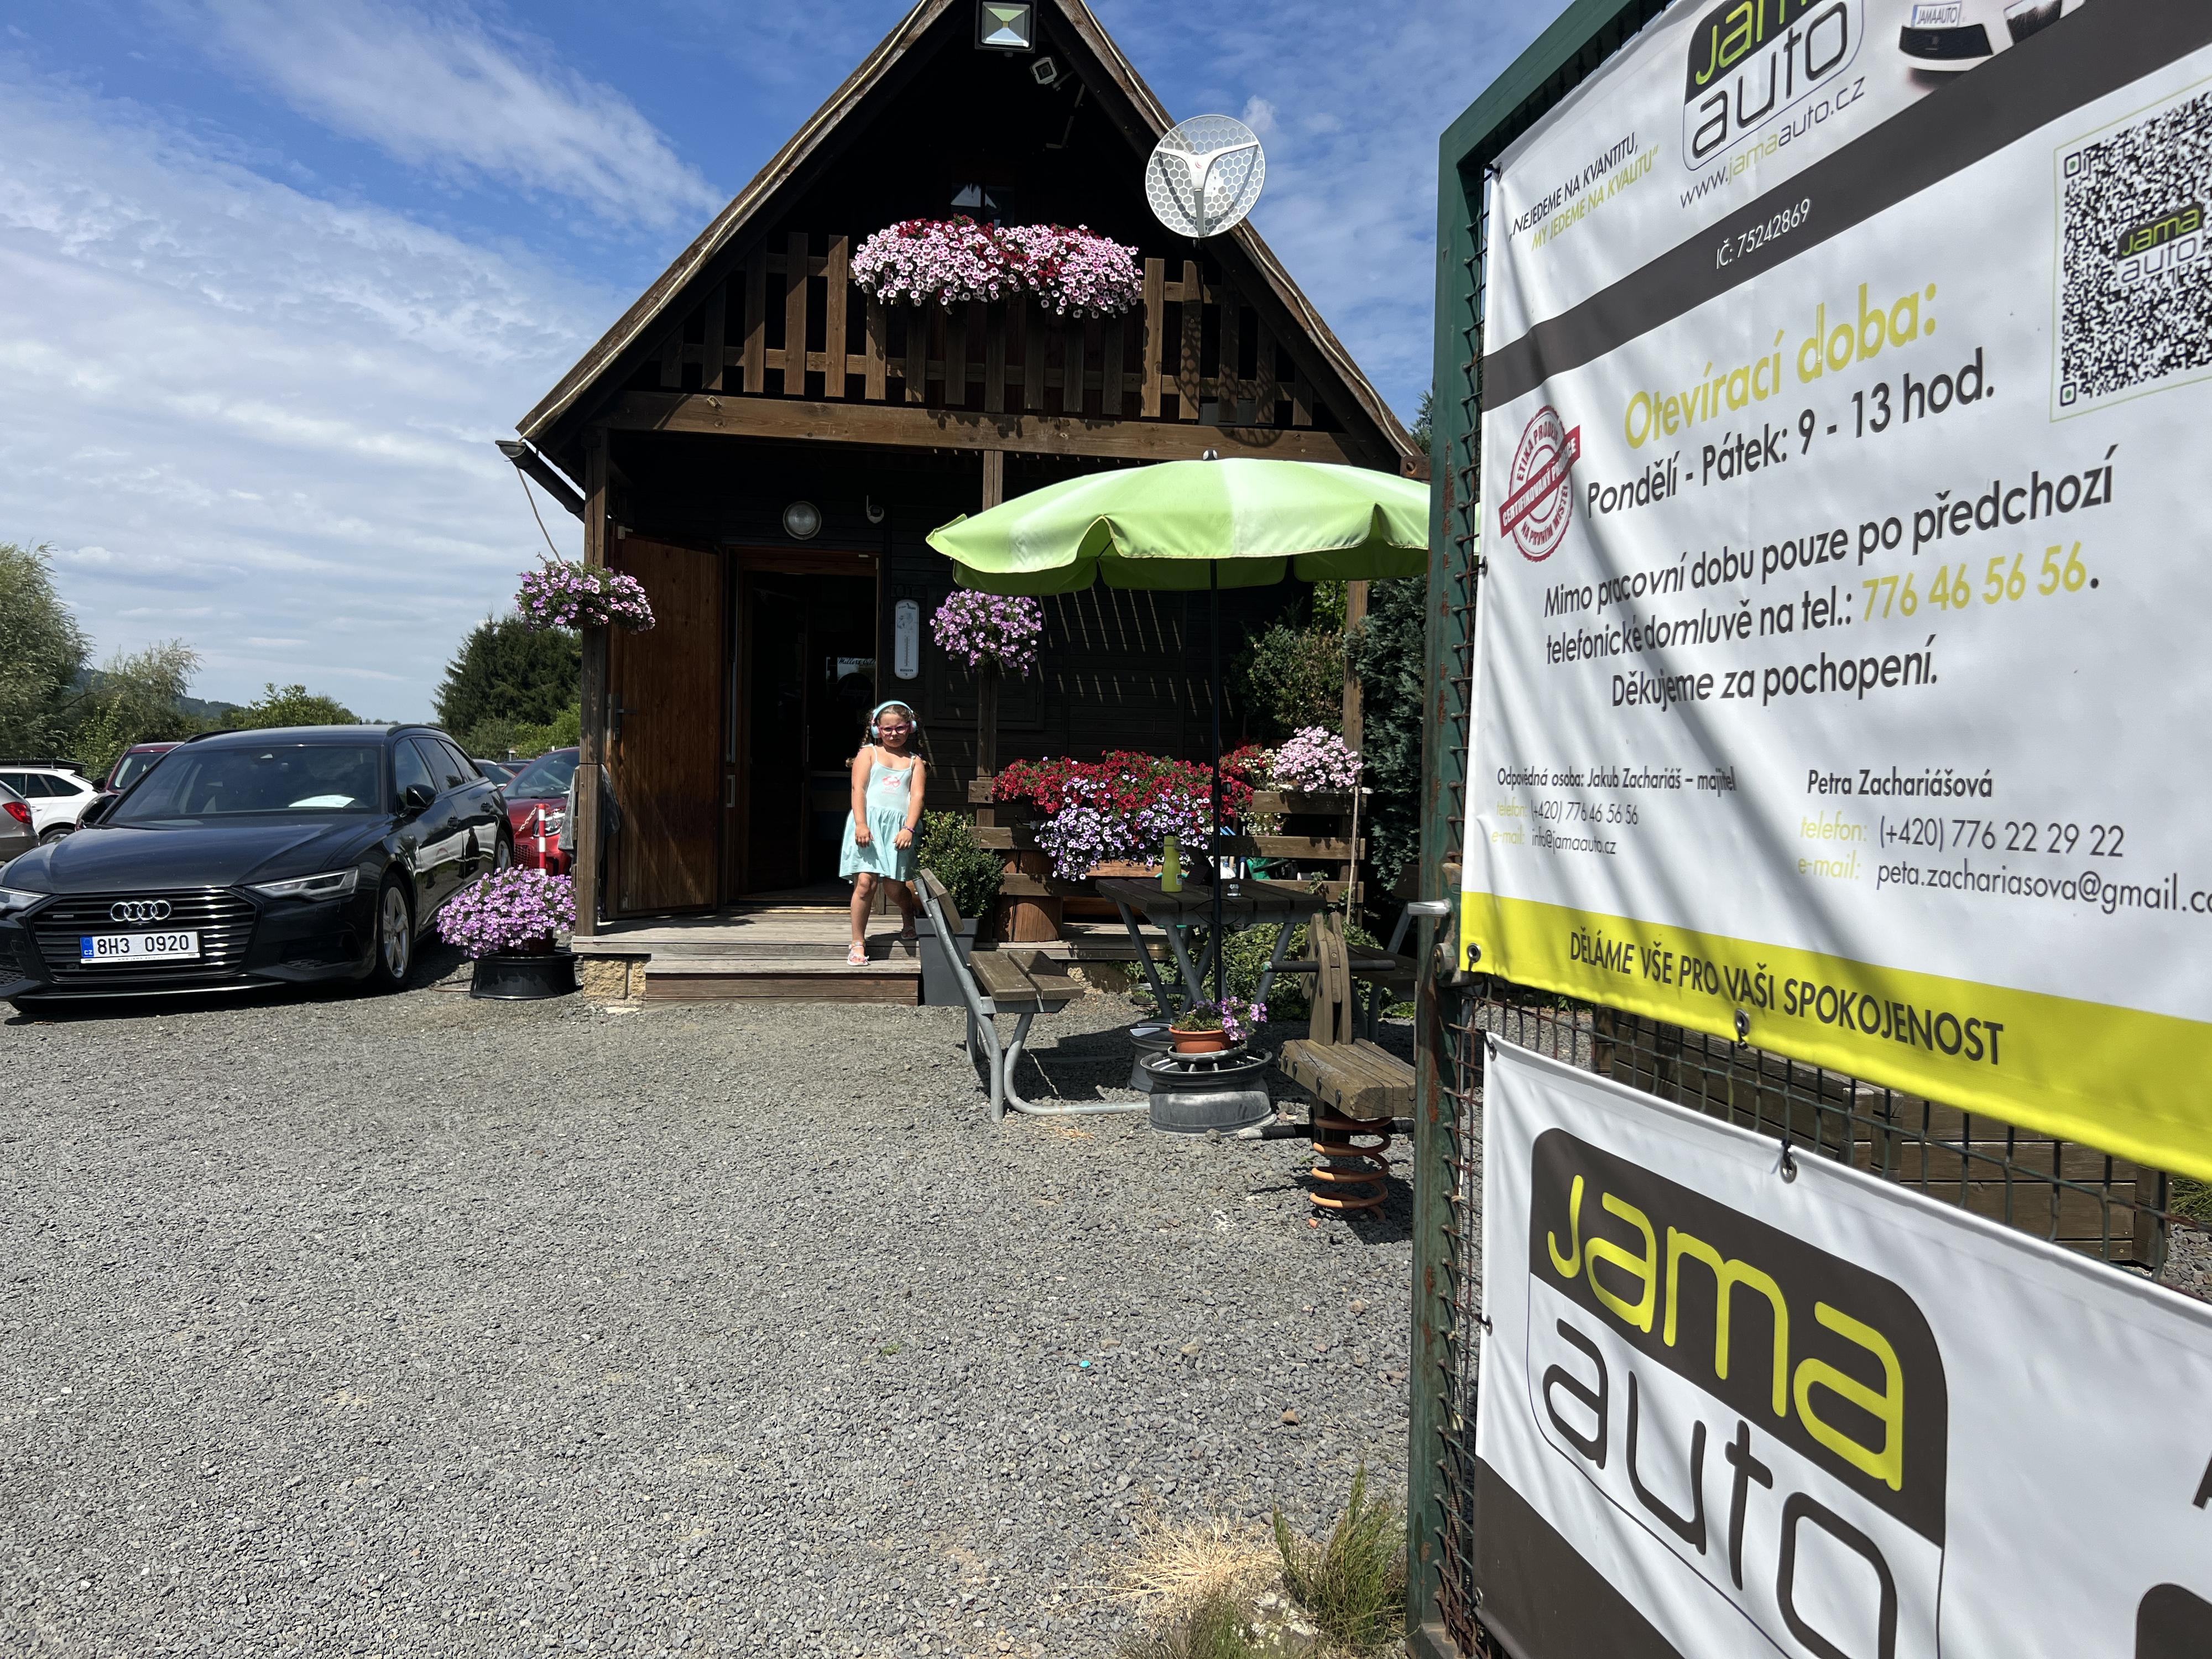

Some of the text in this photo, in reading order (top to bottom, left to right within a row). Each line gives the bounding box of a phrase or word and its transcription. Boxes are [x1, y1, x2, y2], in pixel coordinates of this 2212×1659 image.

[1917, 7, 1958, 24] JAMAAUTO
[1692, 1, 1847, 159] auto
[1564, 176, 1580, 197] NA
[1583, 132, 1638, 186] KVANTITU,
[1680, 76, 1865, 207] www.jamaauto.cz
[1531, 229, 1546, 252] MY
[1549, 200, 1586, 239] JEDEME
[1588, 189, 1604, 210] NA
[1715, 198, 1811, 269] IČ: 75242869
[2121, 237, 2196, 283] auto
[1624, 283, 1937, 449] Otevírací doba:
[1588, 450, 1681, 518] Pondělí
[1702, 422, 1788, 487] Pátek:
[1799, 409, 1815, 456] 9
[1850, 383, 1891, 439] 13
[1902, 346, 1995, 424] hod.
[1544, 443, 2119, 618] Mimo pracovní dobu pouze po předchozí
[1547, 540, 2099, 665] telefonické domluvě na tel.: 776 46 56 56.
[1612, 634, 1937, 712] Děkujeme za pochopení.
[1496, 796, 1638, 825] telefon: (+420) 776 46 56 56
[1498, 766, 1547, 791] Odpovědná
[1552, 766, 1583, 787] osoba:
[1587, 766, 1619, 788] Jakub
[1622, 765, 1681, 790] Zachariáš
[1697, 766, 1737, 797] majitel
[1807, 766, 1992, 798] Petra Zachariášová
[1491, 825, 1616, 855] e-mail: info@jamaauto.cz
[1801, 810, 2125, 857] telefon: (+420) 776 22 29 22
[1798, 850, 2212, 914] e-mail: peta.zachariasova@gmail.c
[97, 935, 189, 954] 8H3 0920
[1571, 926, 2004, 1065] DĚLÁME VŠE PRO VAŠI SPOKOJENOST
[1542, 1318, 1898, 1659] auto
